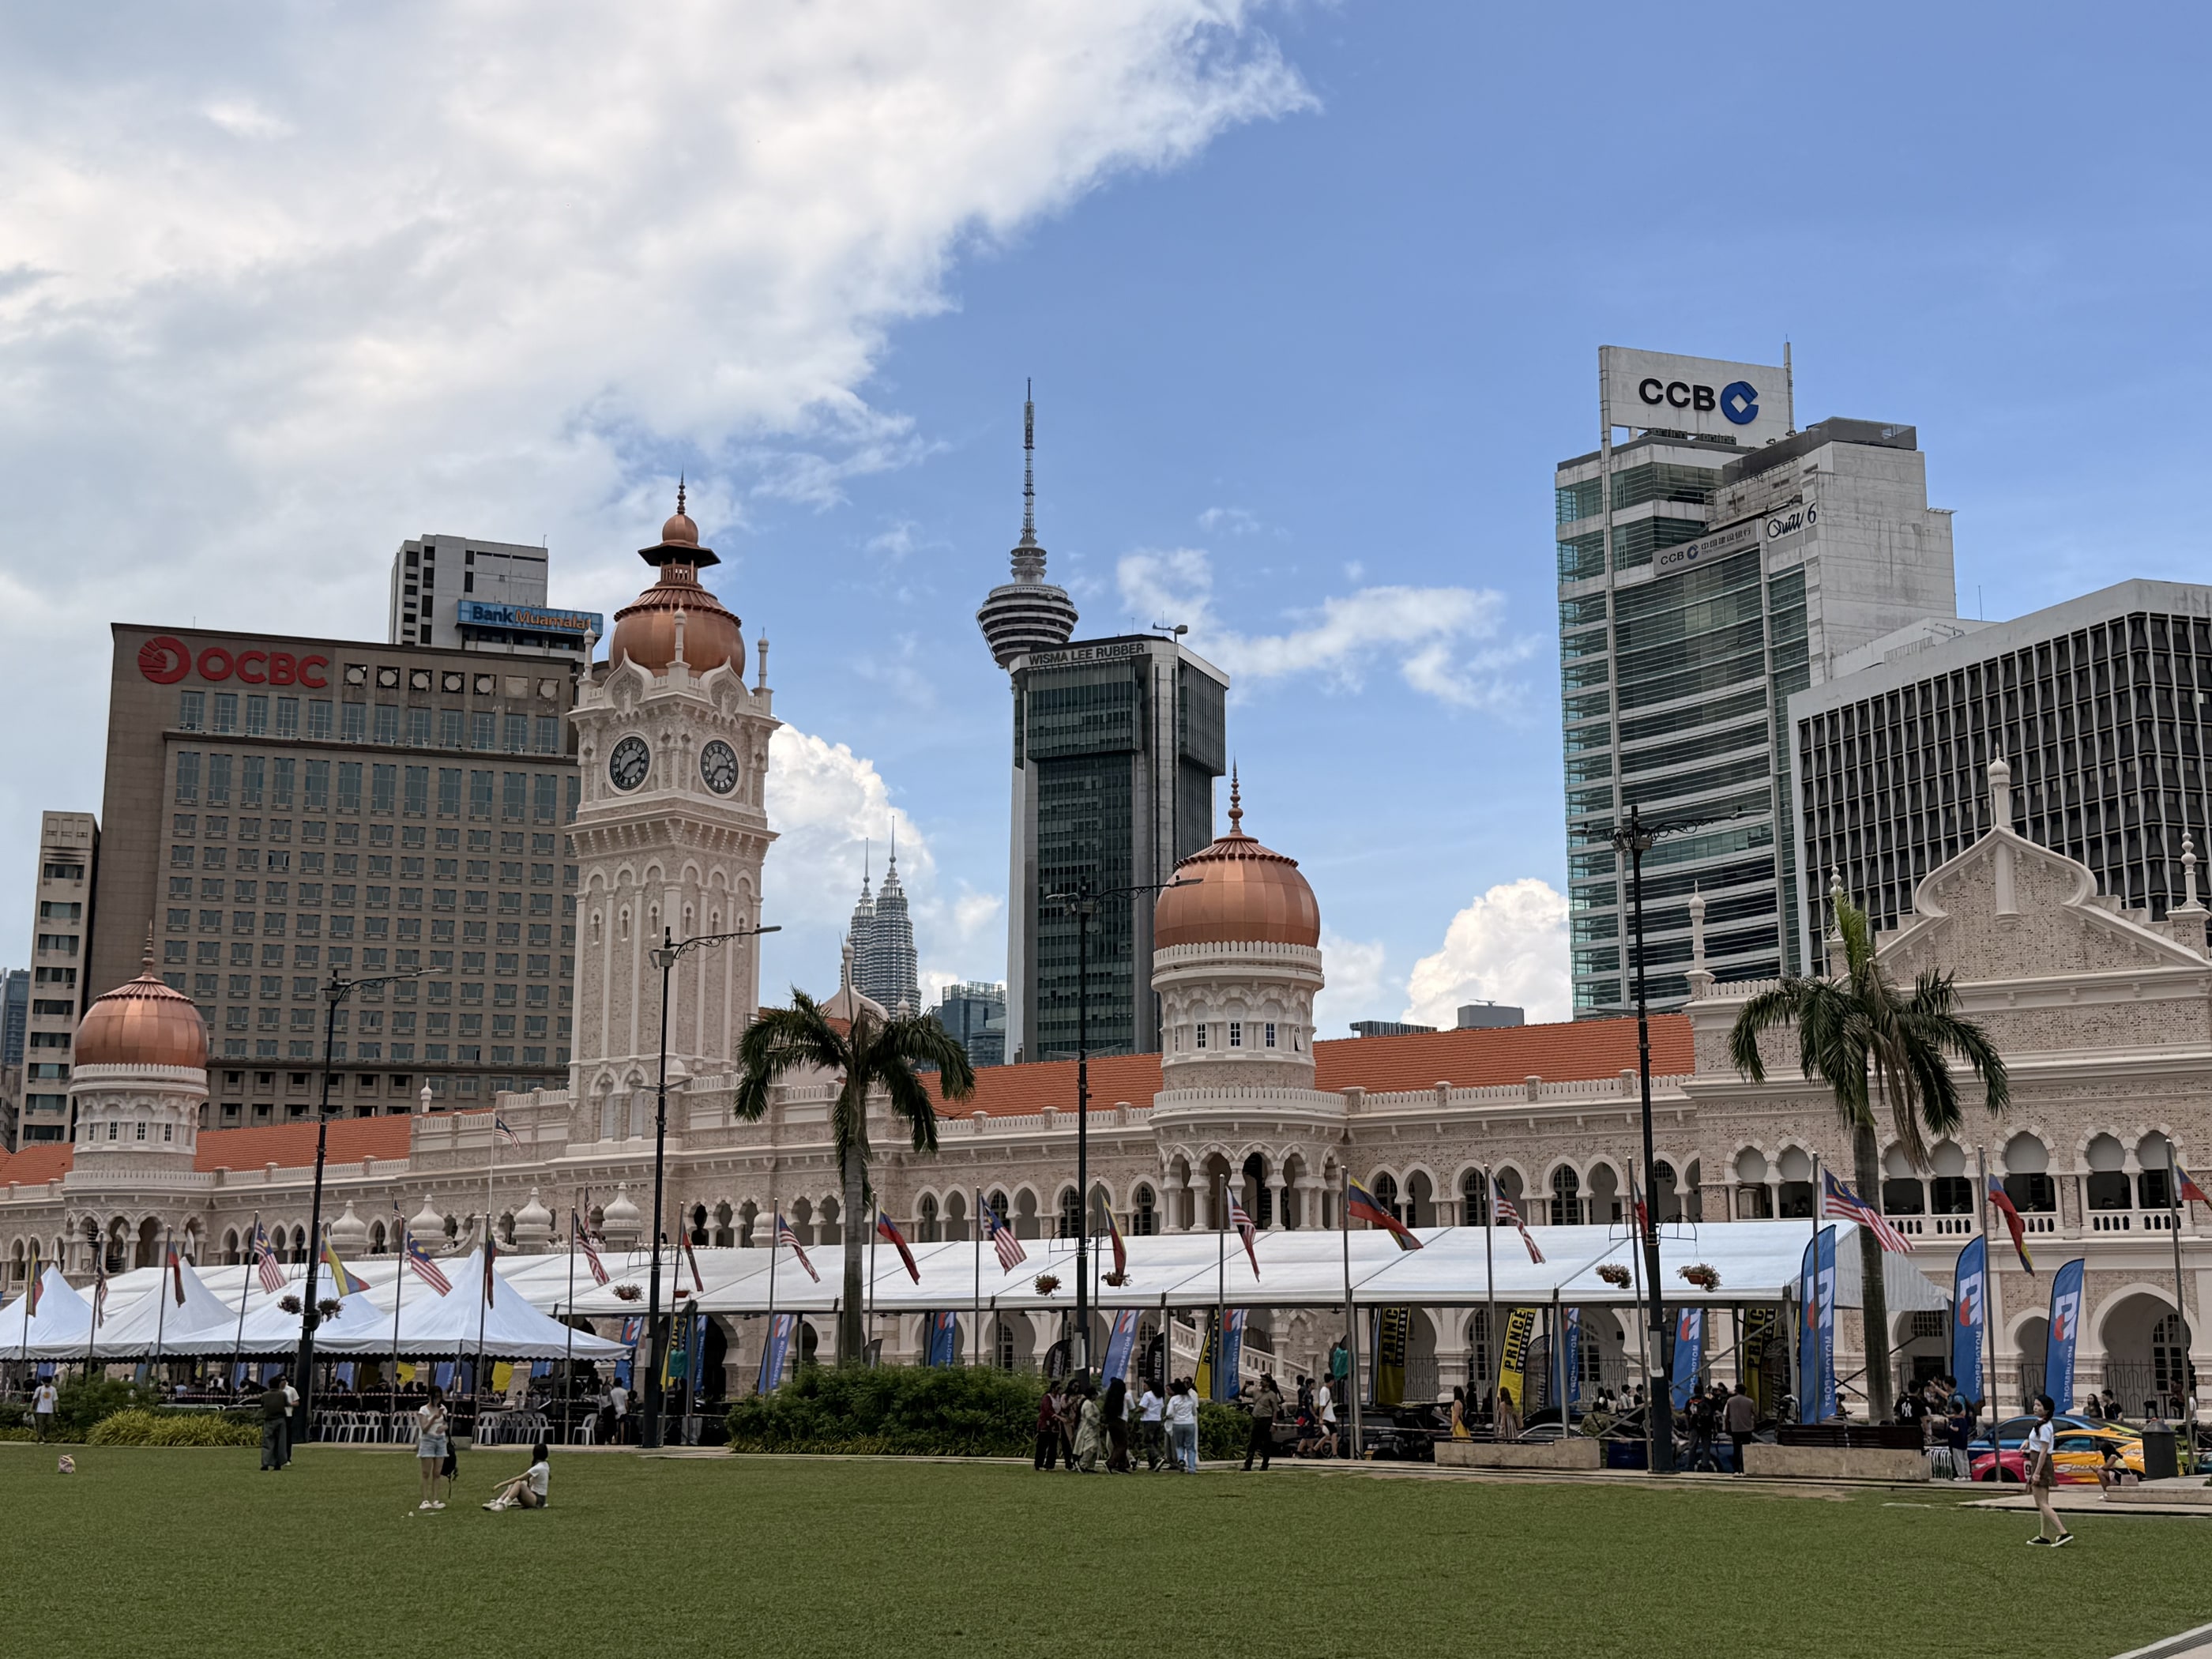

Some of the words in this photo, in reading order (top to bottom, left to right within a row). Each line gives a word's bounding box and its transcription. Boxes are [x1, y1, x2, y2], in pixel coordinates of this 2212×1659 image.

[1638, 378, 1716, 411] CCB
[1767, 510, 1804, 538] Quill
[1807, 502, 1816, 524] 6
[1661, 551, 1684, 566] CCB
[473, 605, 514, 623] Bank
[515, 609, 592, 630] Muamalat
[198, 647, 329, 688] OCBC
[1029, 652, 1068, 665] WISMA
[1071, 649, 1093, 660] LEE
[1096, 643, 1145, 658] RUBBER
[1382, 1308, 1398, 1365] PRINC
[1396, 1307, 1407, 1366] LUBRICANT
[1504, 1311, 1526, 1371] PRINCE
[1747, 1308, 1764, 1368] PRINC
